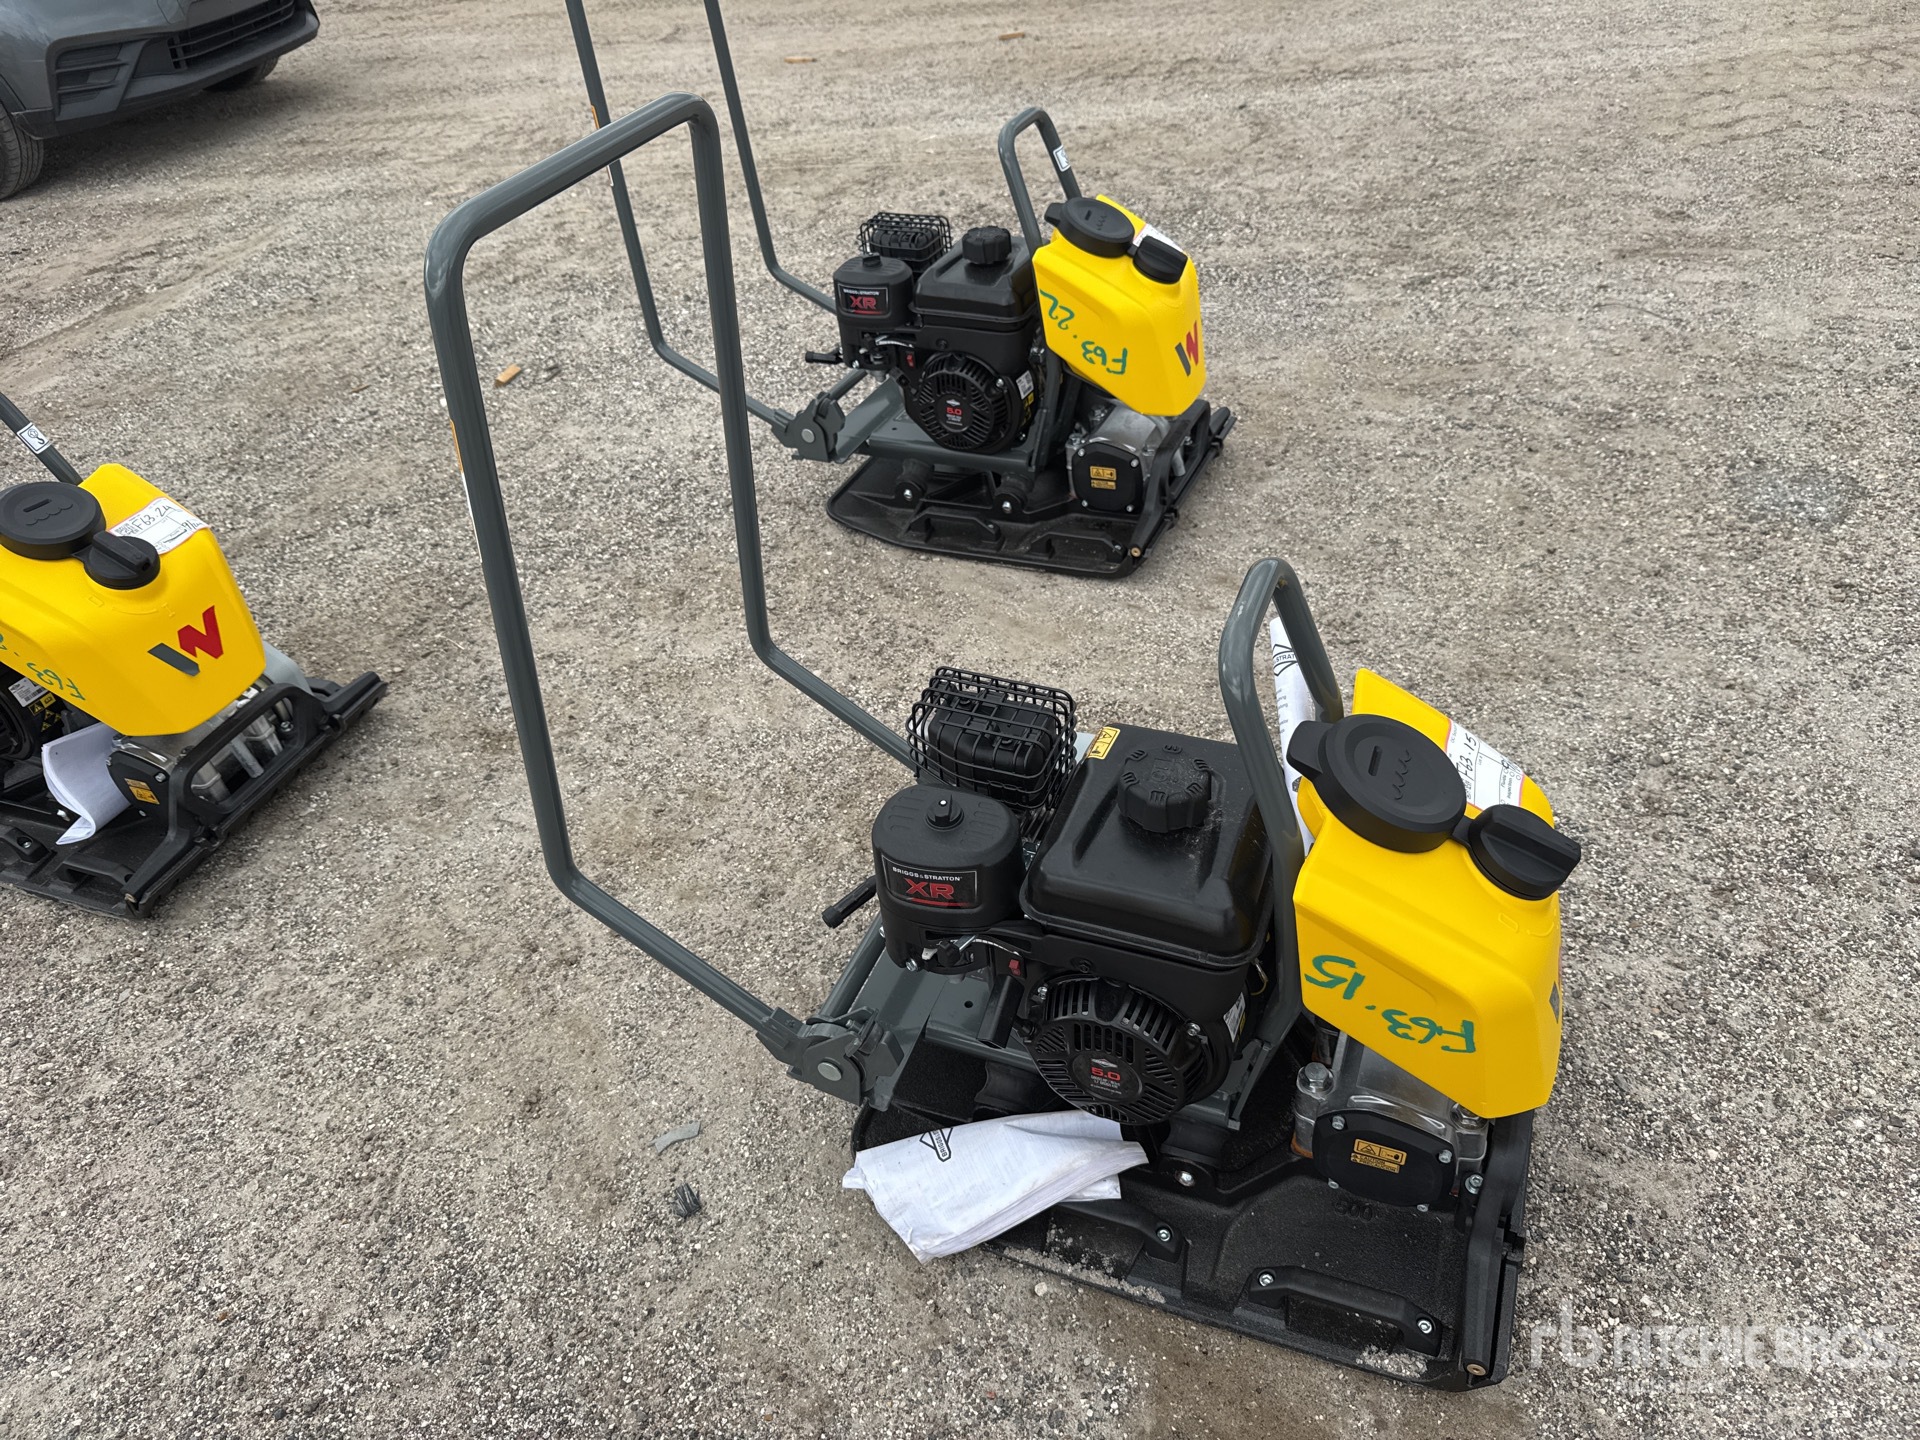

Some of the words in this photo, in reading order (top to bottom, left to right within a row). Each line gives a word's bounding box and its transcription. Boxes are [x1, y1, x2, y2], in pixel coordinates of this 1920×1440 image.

[850, 295, 877, 310] XR
[903, 877, 955, 900] XR
[1091, 1066, 1121, 1081] 5.0
